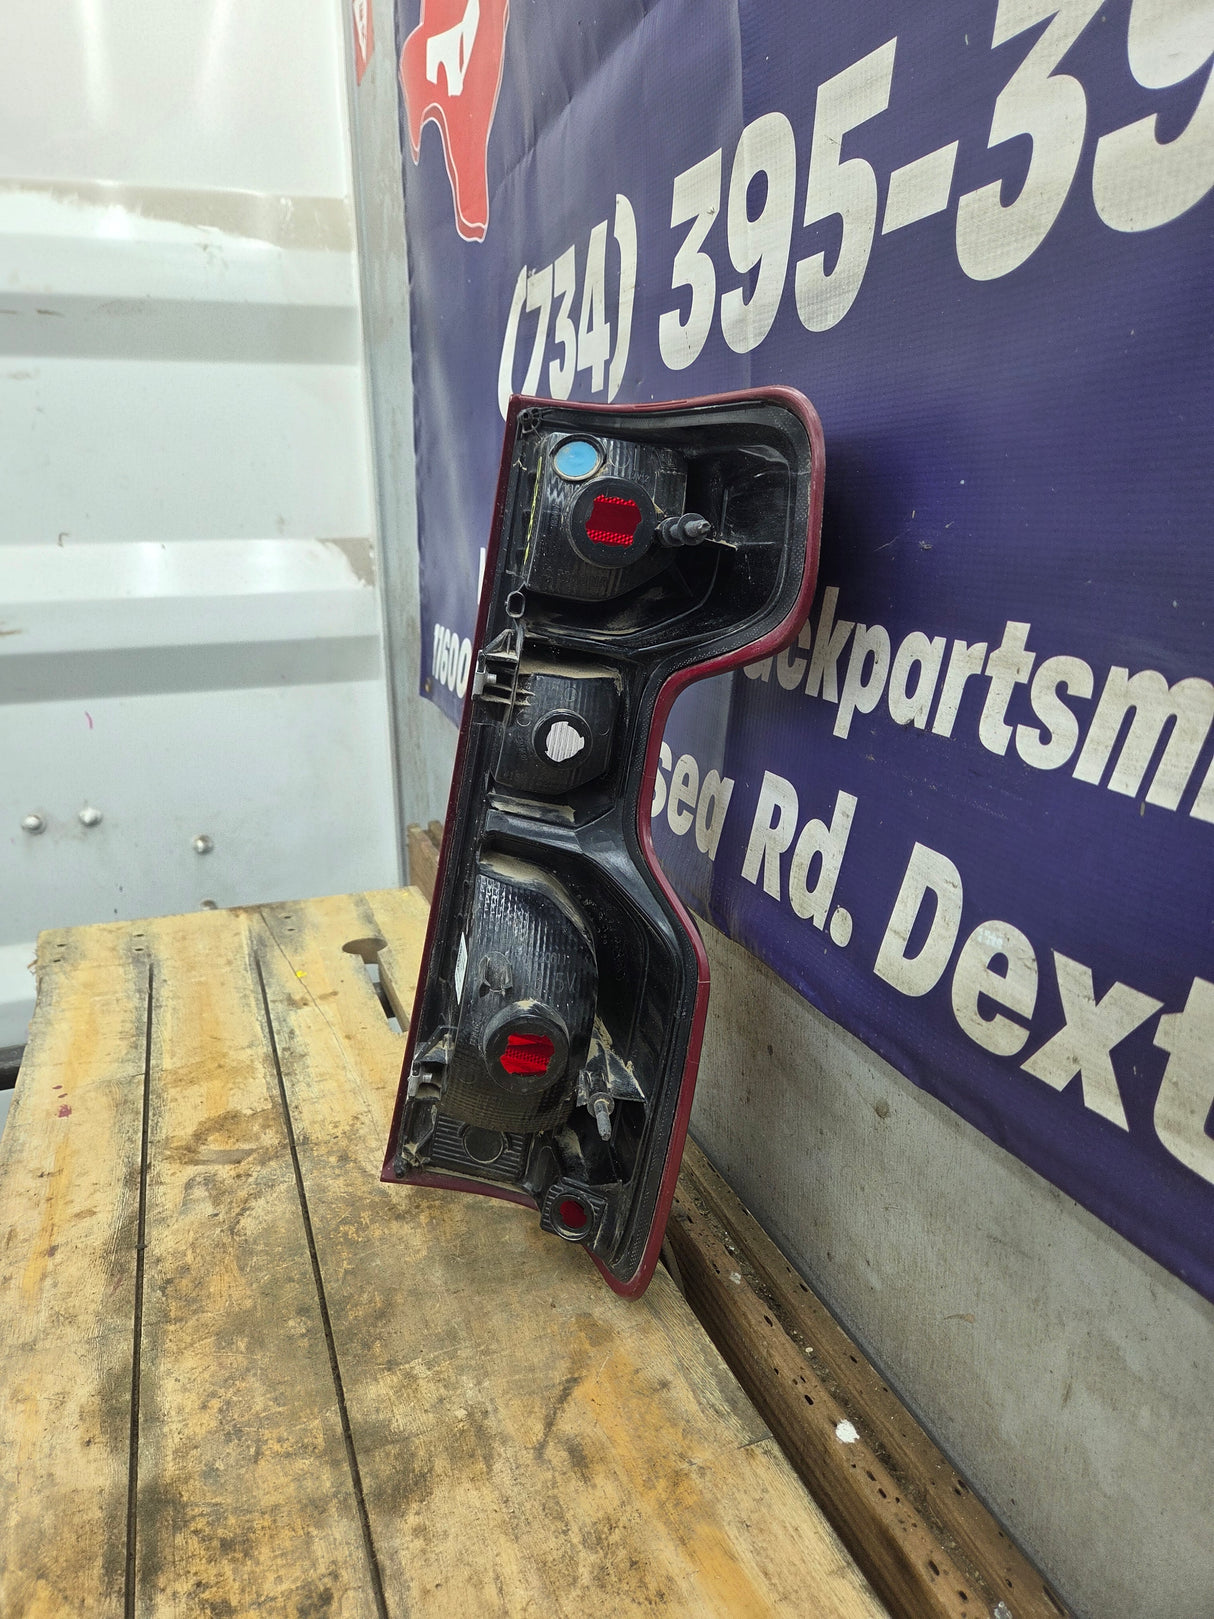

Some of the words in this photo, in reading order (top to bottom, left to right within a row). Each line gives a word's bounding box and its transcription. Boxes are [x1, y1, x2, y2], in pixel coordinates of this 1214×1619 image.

[498, 194, 637, 422] (734)
[743, 586, 1214, 824] ckpartsm
[741, 770, 858, 948] Rd.
